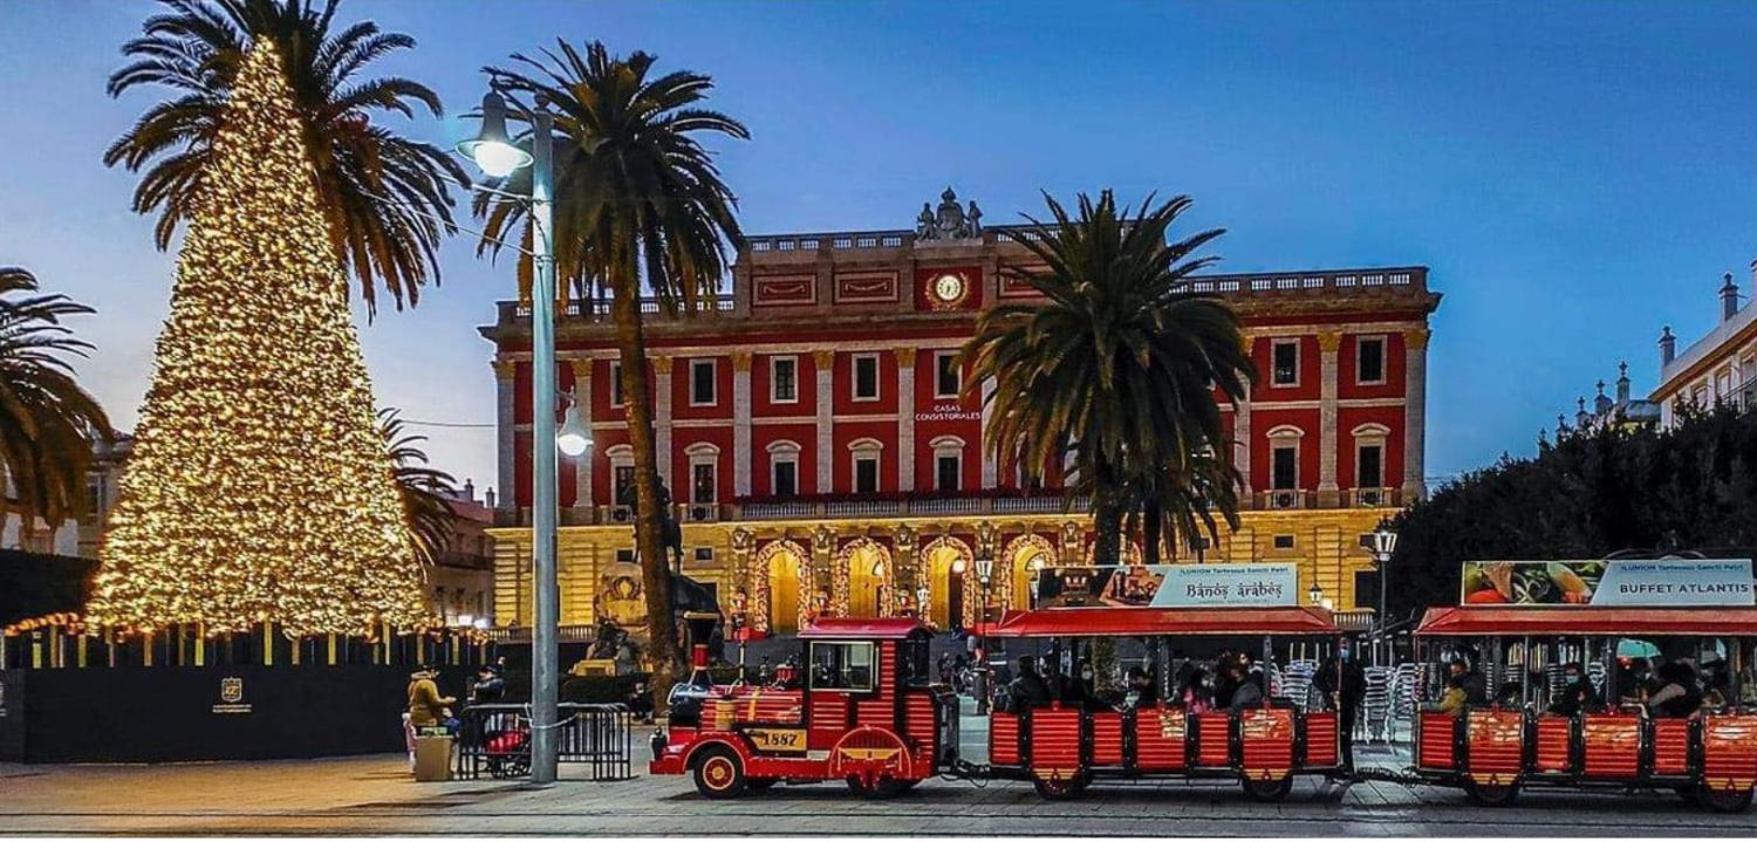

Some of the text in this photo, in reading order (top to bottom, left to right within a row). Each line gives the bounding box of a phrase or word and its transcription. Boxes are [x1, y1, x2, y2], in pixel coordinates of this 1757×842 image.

[934, 404, 961, 412] CASAS
[1620, 584, 1749, 594] BUFFET ATLANTIS
[764, 732, 798, 747] 1887
